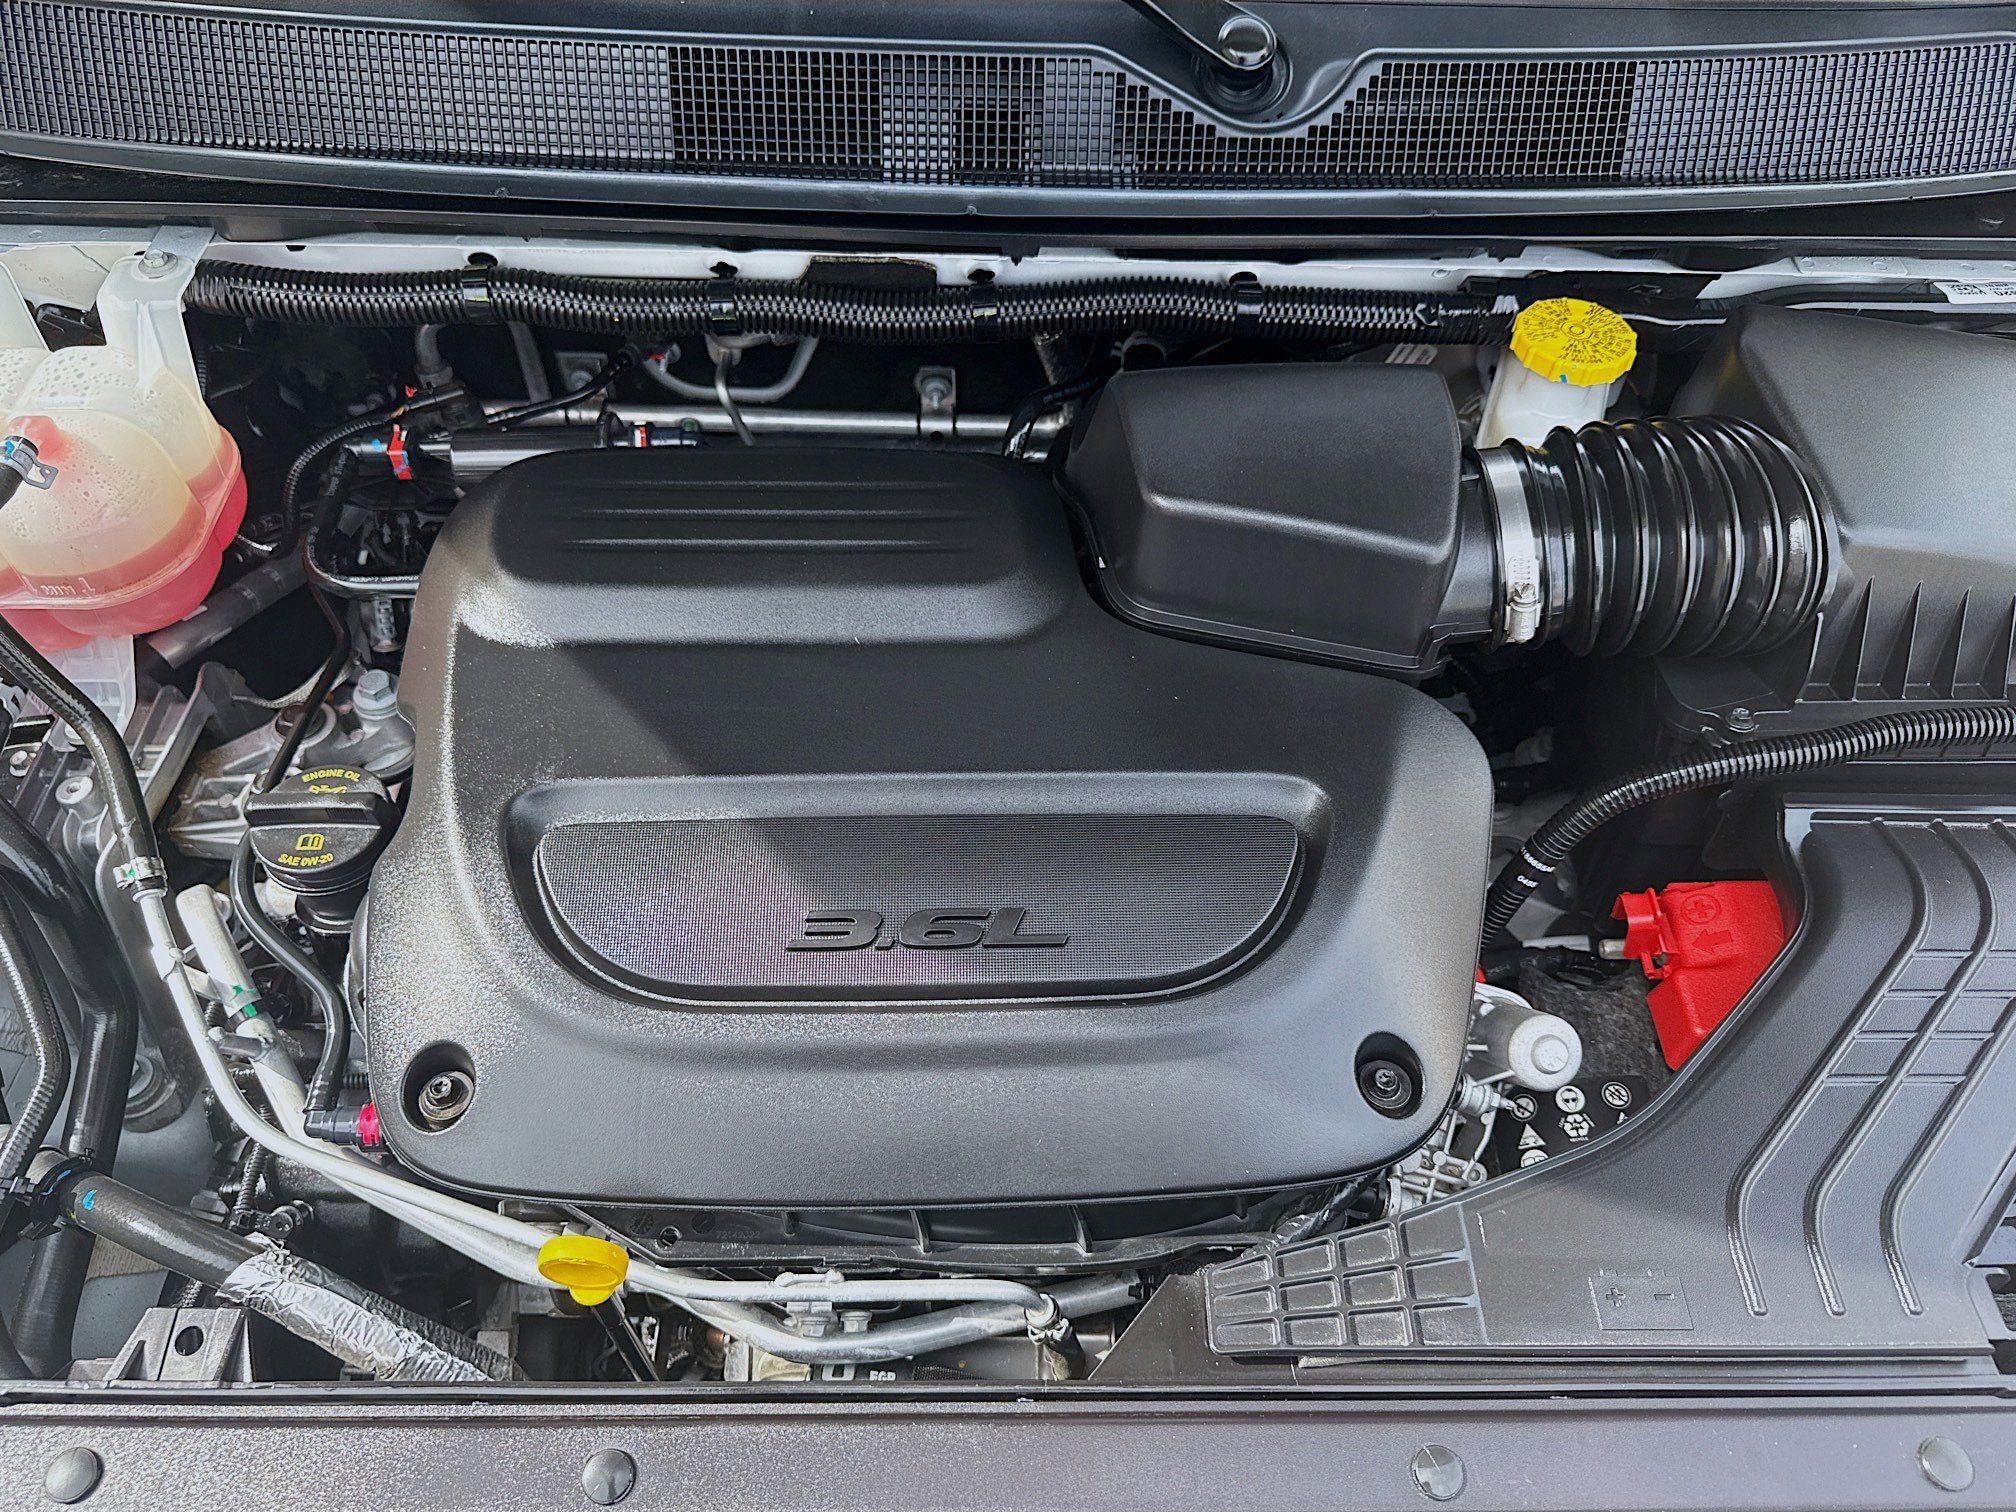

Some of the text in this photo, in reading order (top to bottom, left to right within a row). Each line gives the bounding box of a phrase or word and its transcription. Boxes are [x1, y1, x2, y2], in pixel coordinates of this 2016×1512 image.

[301, 769, 362, 783] ENGINE OIL
[277, 853, 334, 866] SAE 0W-20
[786, 908, 1069, 950] 3.6L
